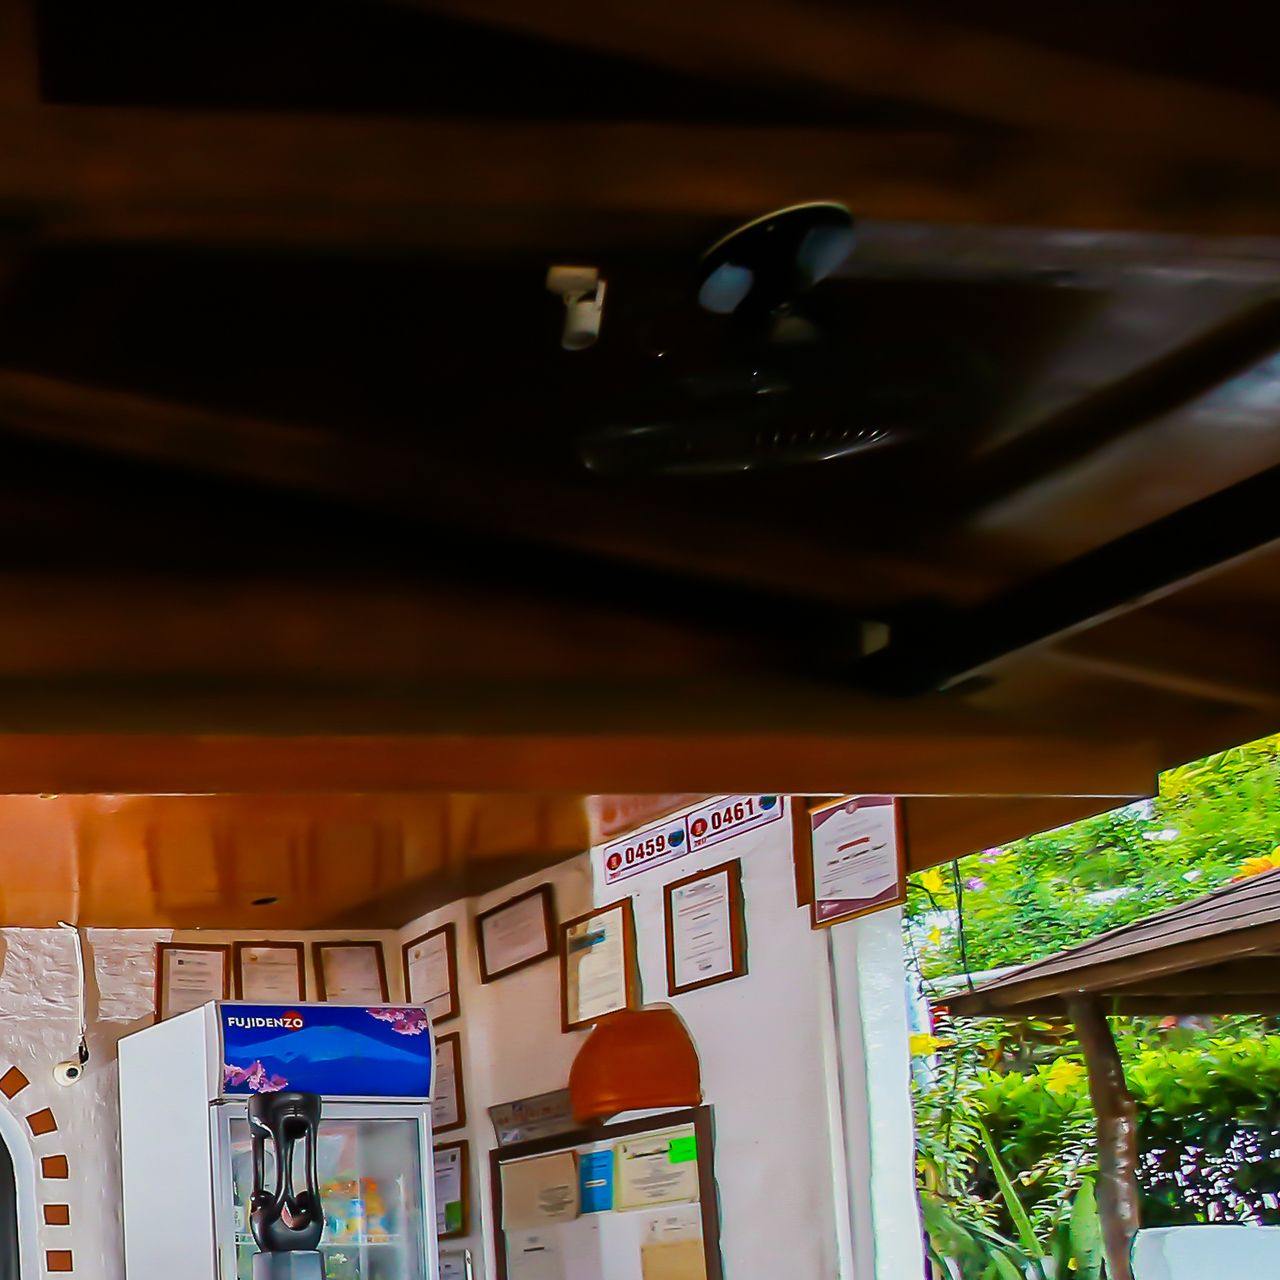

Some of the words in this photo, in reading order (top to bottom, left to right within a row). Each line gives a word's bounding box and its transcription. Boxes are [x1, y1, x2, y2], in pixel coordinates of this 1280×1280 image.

[711, 797, 754, 830] 0461
[625, 834, 666, 864] 0459
[227, 1016, 303, 1028] FUJIDENZO
